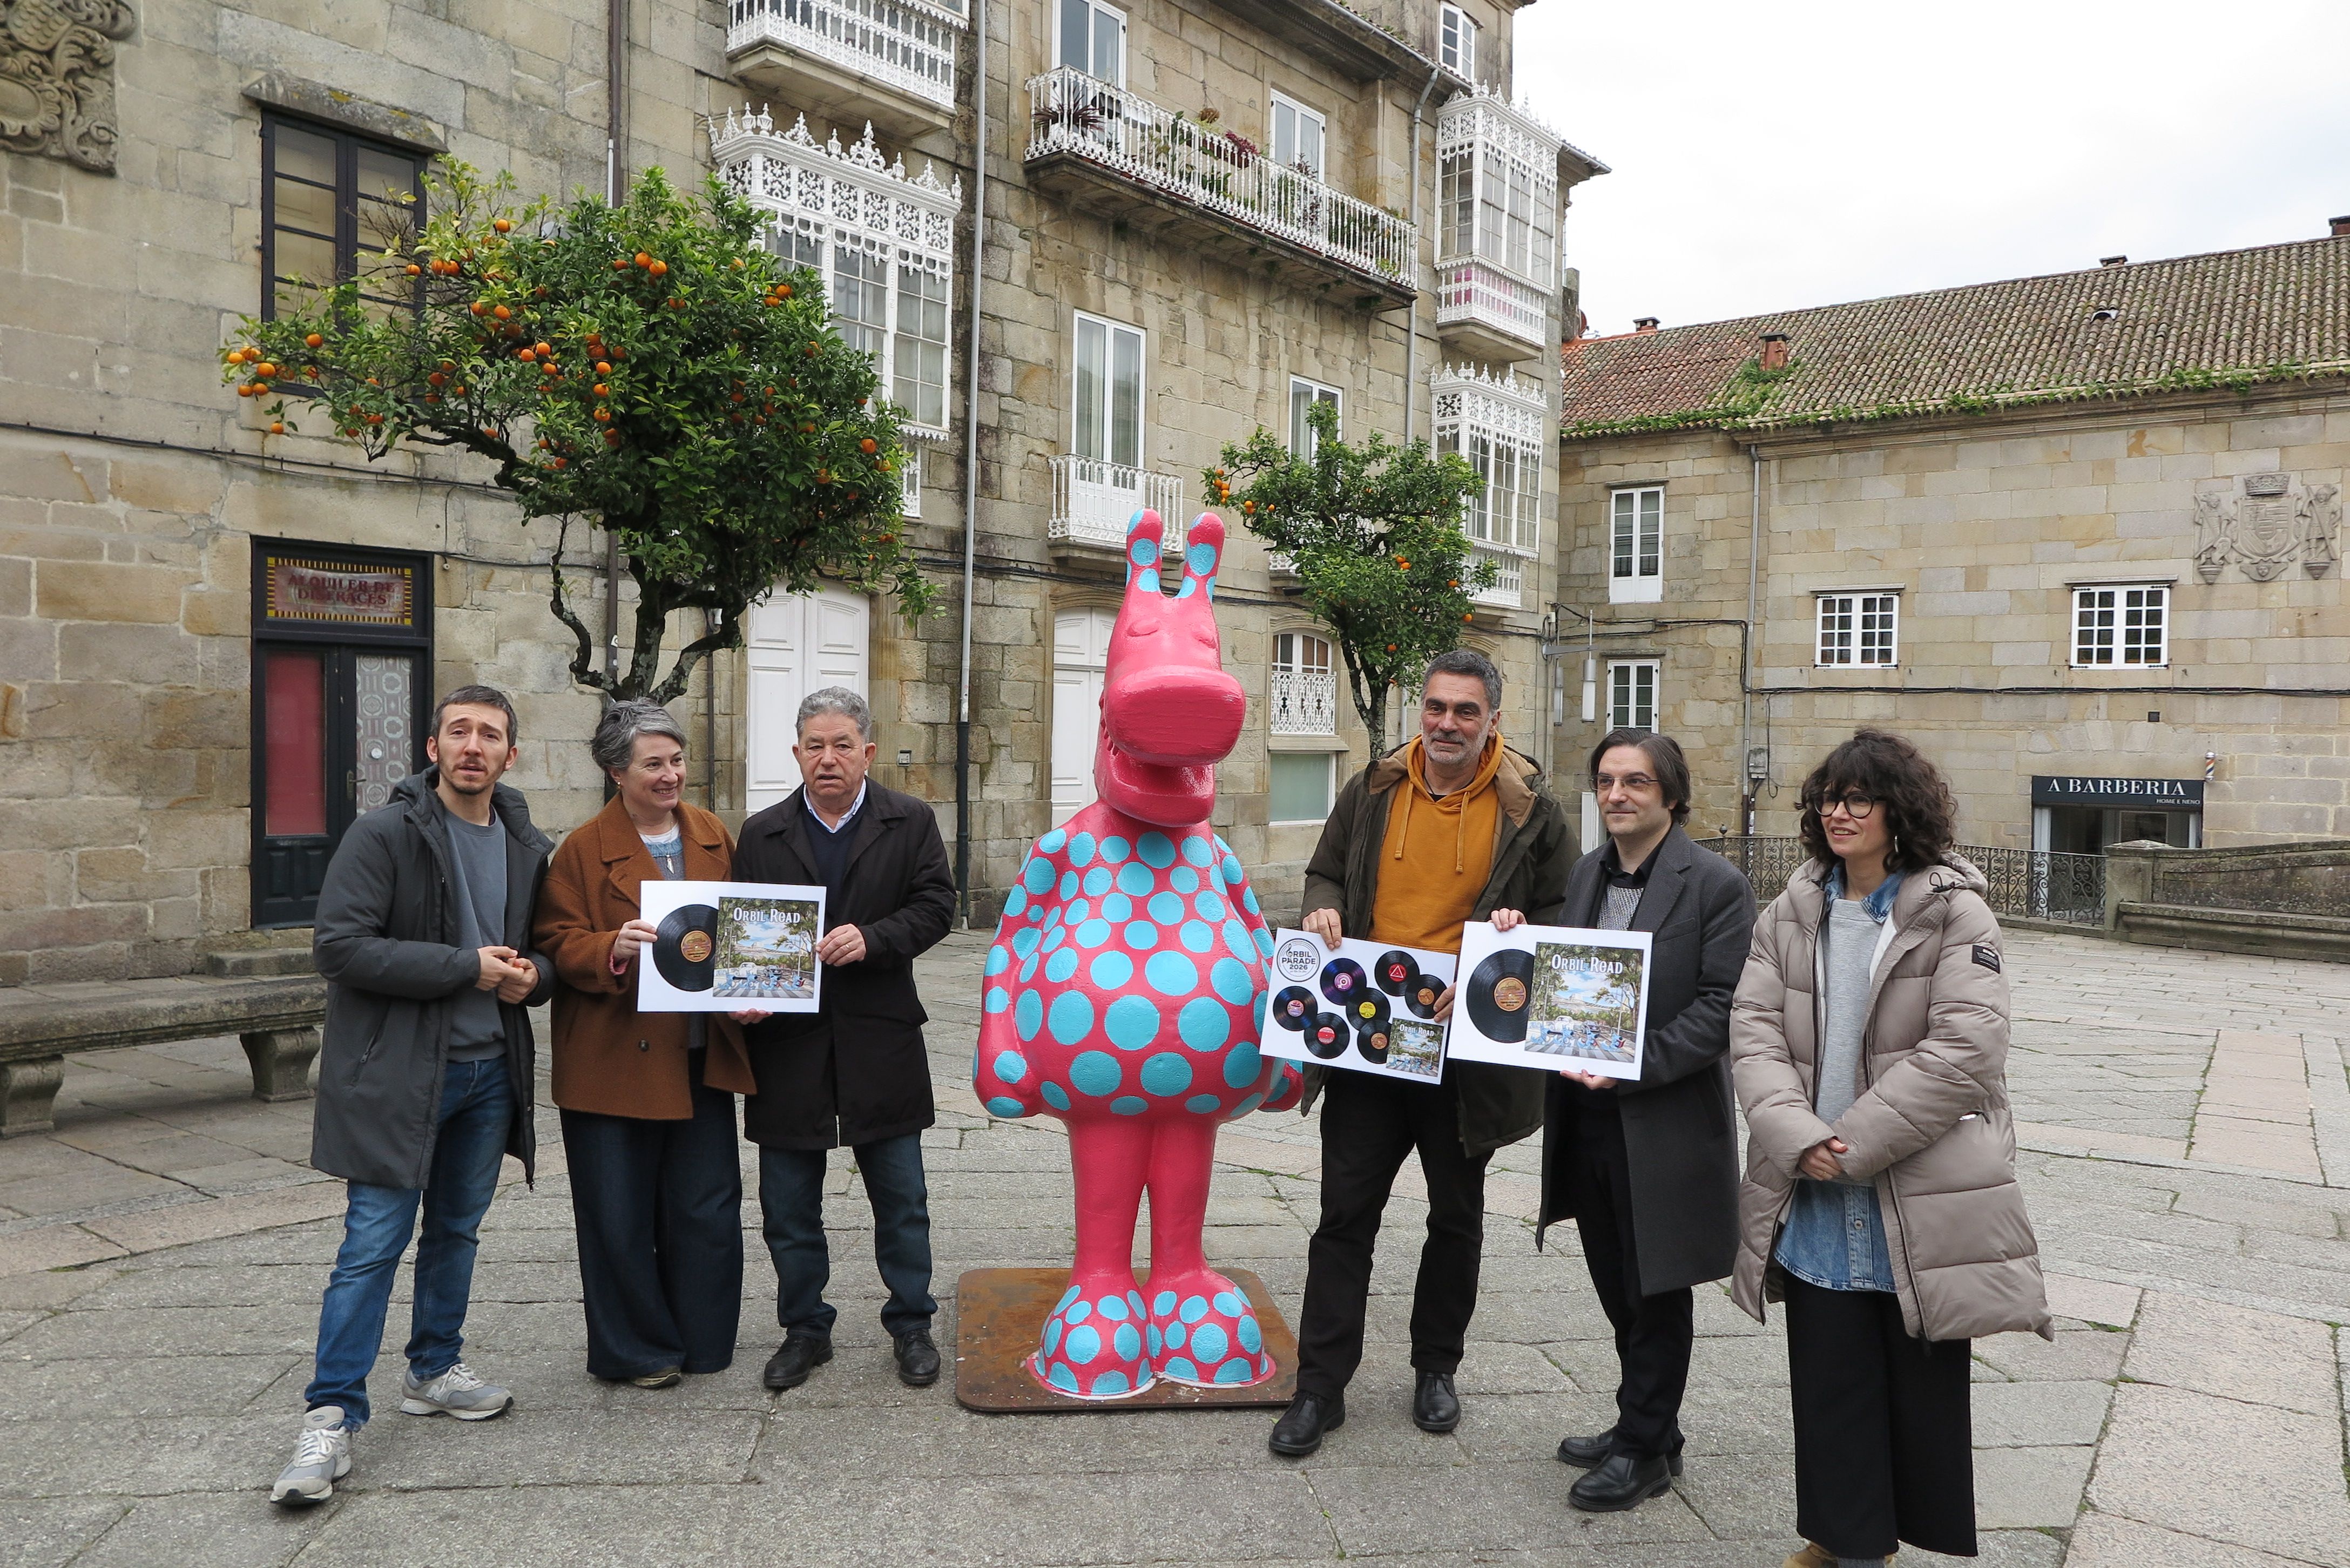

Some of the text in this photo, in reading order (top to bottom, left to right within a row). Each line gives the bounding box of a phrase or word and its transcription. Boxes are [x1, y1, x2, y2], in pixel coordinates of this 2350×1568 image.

[288, 574, 395, 592] ALQUILER DE
[298, 589, 387, 605] DISFRACES
[2047, 778, 2186, 796] A BARBERIA
